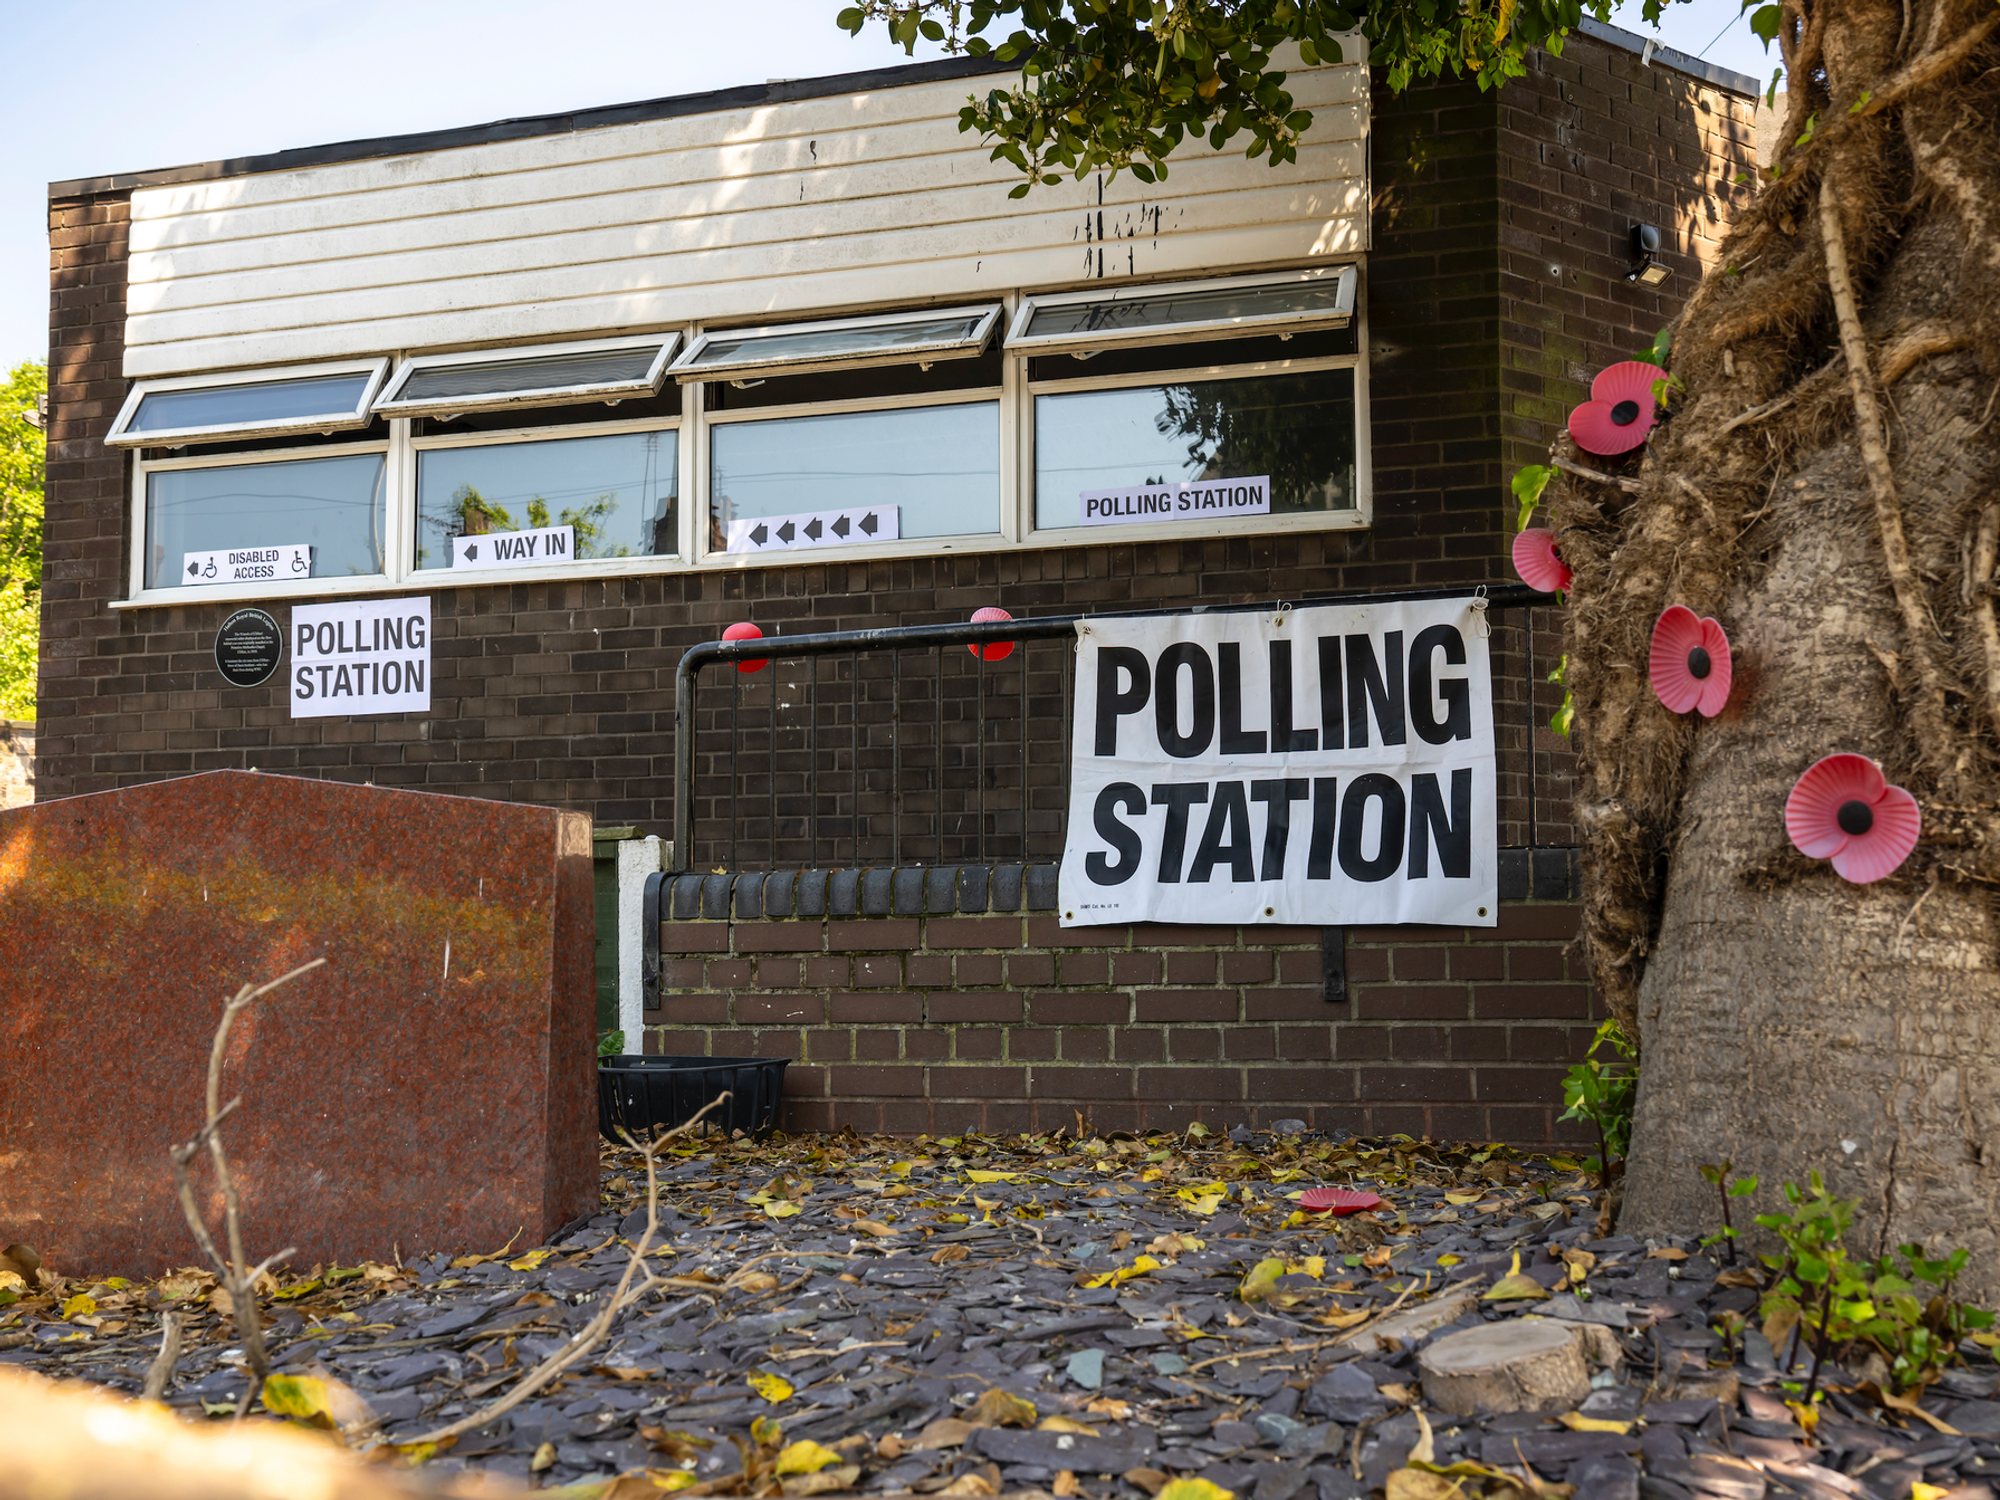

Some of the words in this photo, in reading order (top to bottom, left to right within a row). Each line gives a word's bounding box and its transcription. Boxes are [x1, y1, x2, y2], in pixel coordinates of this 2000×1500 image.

[1087, 493, 1171, 518] POLLING
[1178, 486, 1262, 511] STATION
[229, 550, 279, 565] DISABLED
[494, 535, 538, 560] WAY
[545, 533, 565, 555] IN
[234, 565, 274, 579] ACCESS
[297, 615, 425, 656] POLLING
[295, 660, 425, 699] STATION
[1094, 624, 1472, 758] POLLING
[1085, 768, 1472, 886] STATION
